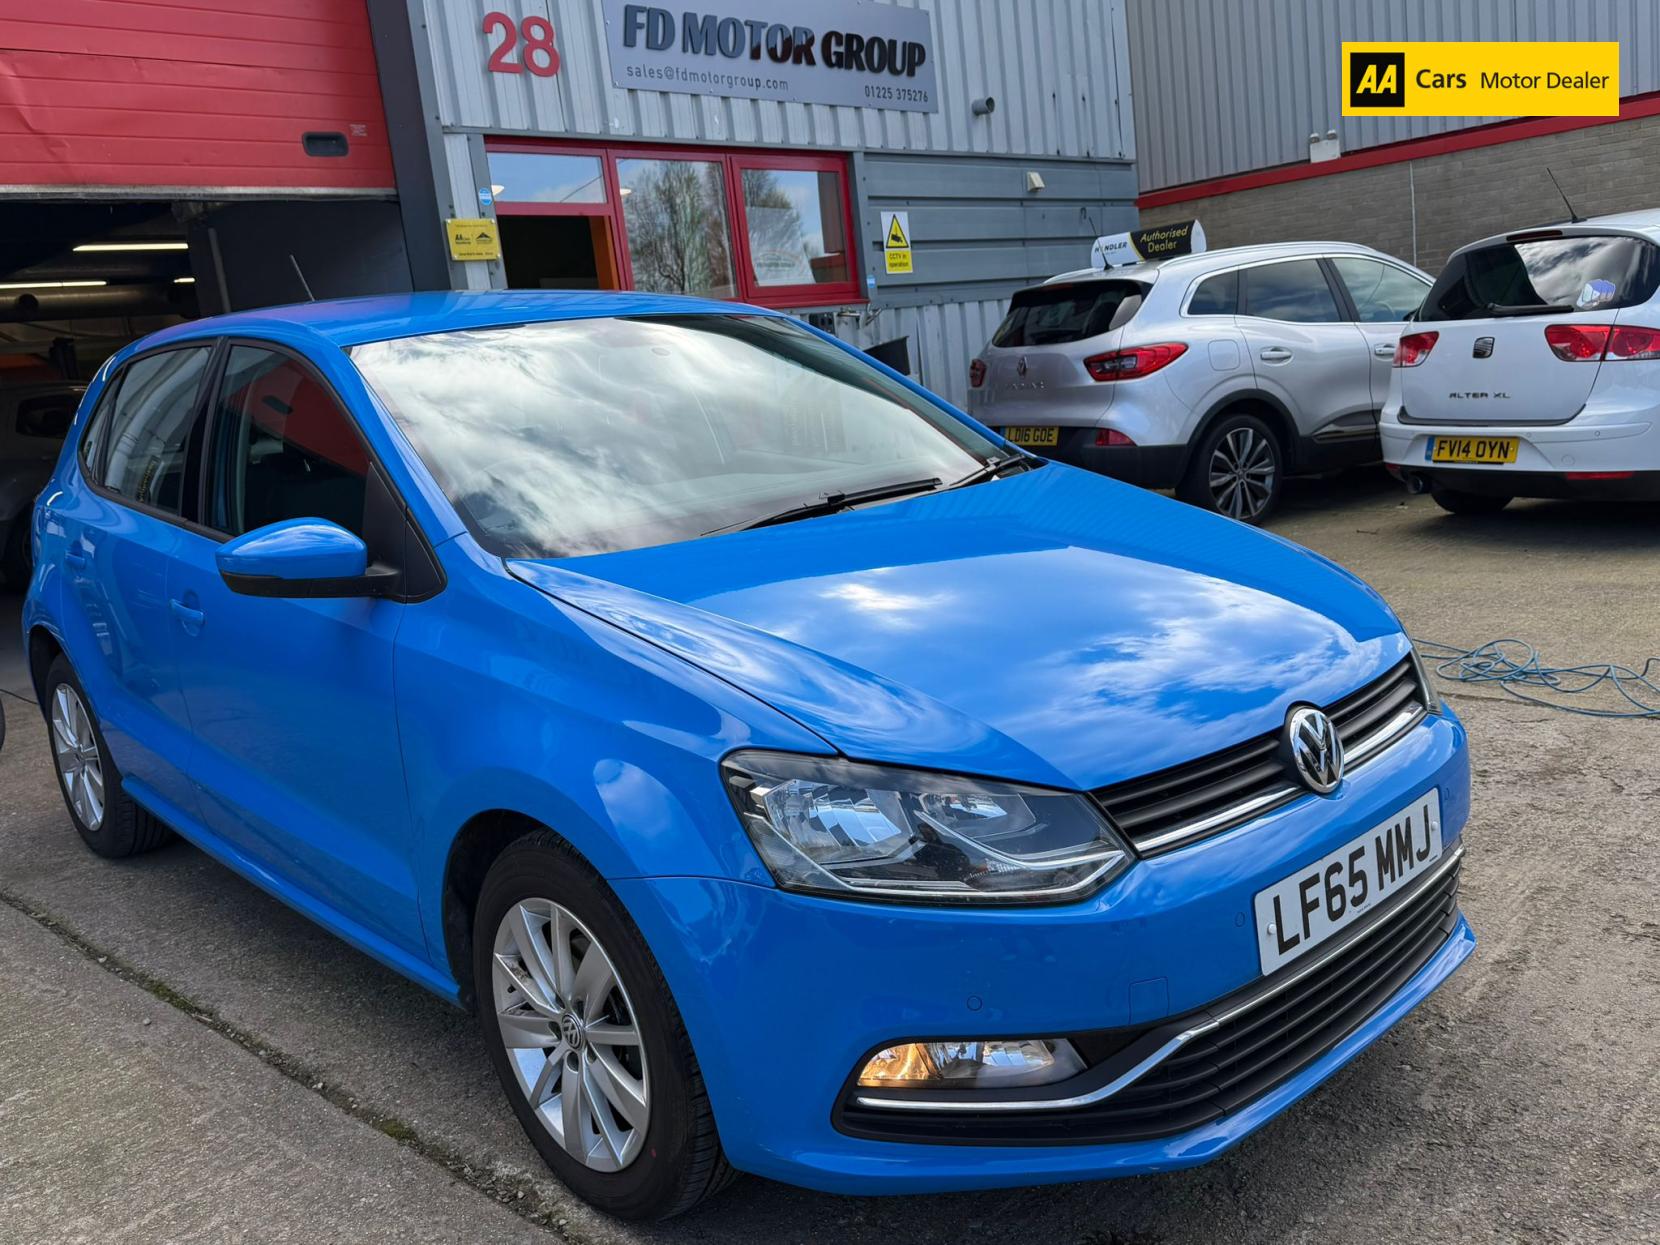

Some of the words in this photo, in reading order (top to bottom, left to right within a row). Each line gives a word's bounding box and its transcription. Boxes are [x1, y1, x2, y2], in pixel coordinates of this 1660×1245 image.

[482, 11, 561, 77] 28
[623, 4, 676, 51] FD
[682, 11, 816, 66] MOTOR
[821, 30, 926, 77] GROUP
[626, 64, 789, 91] sales@fdmotorgroup.com
[864, 85, 893, 100] 01225
[895, 88, 929, 103] 375276
[1140, 226, 1189, 241] Authorised
[1147, 240, 1178, 253] Dealer
[1008, 427, 1030, 442] LD16
[1437, 440, 1471, 457] FV14
[1475, 441, 1510, 459] OYN
[1272, 845, 1369, 956] LF65
[1374, 804, 1432, 892] MMJ
